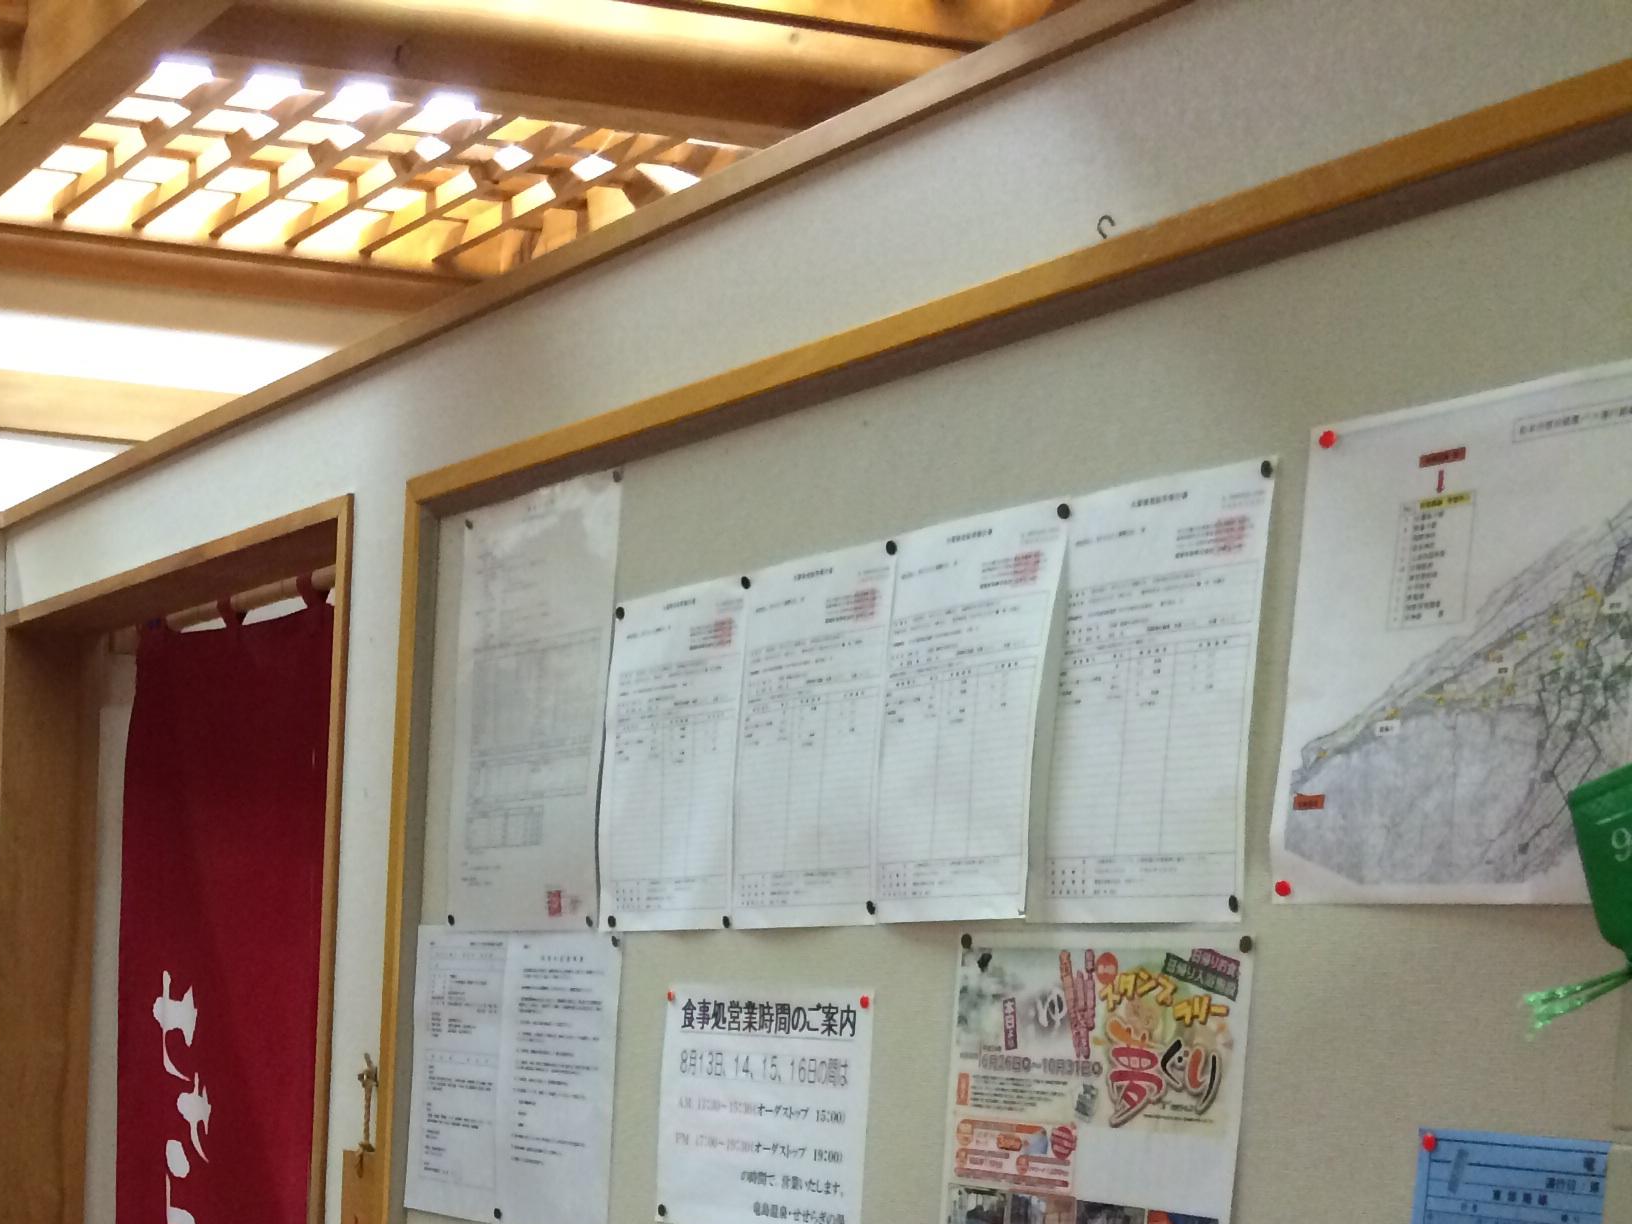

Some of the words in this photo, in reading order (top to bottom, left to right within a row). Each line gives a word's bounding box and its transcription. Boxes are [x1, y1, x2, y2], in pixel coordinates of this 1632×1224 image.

[681, 998, 856, 1037] 食事処営業時間のご案内
